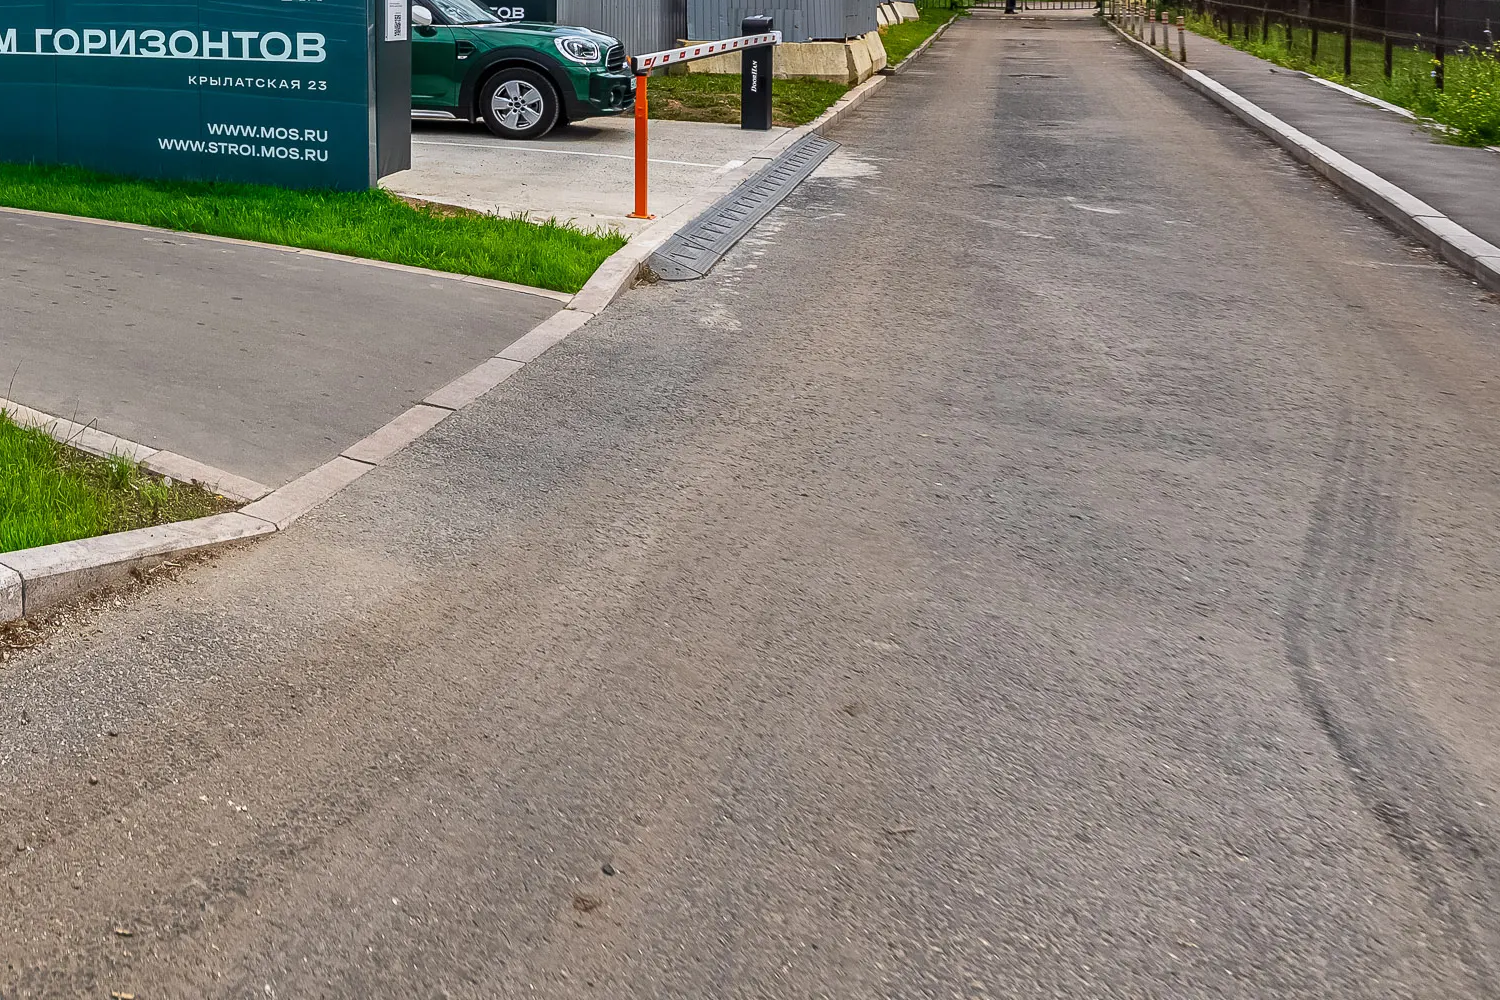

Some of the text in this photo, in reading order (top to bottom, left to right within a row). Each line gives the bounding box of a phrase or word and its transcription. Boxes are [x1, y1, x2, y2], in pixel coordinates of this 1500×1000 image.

[34, 28, 327, 63] ГОРИЗОНТОВ
[188, 75, 328, 91] КРЫЛАТСКАЯ 23
[206, 122, 329, 143] WWW.MOS.RU
[158, 138, 329, 163] WWW.STROI.MOS.RU
